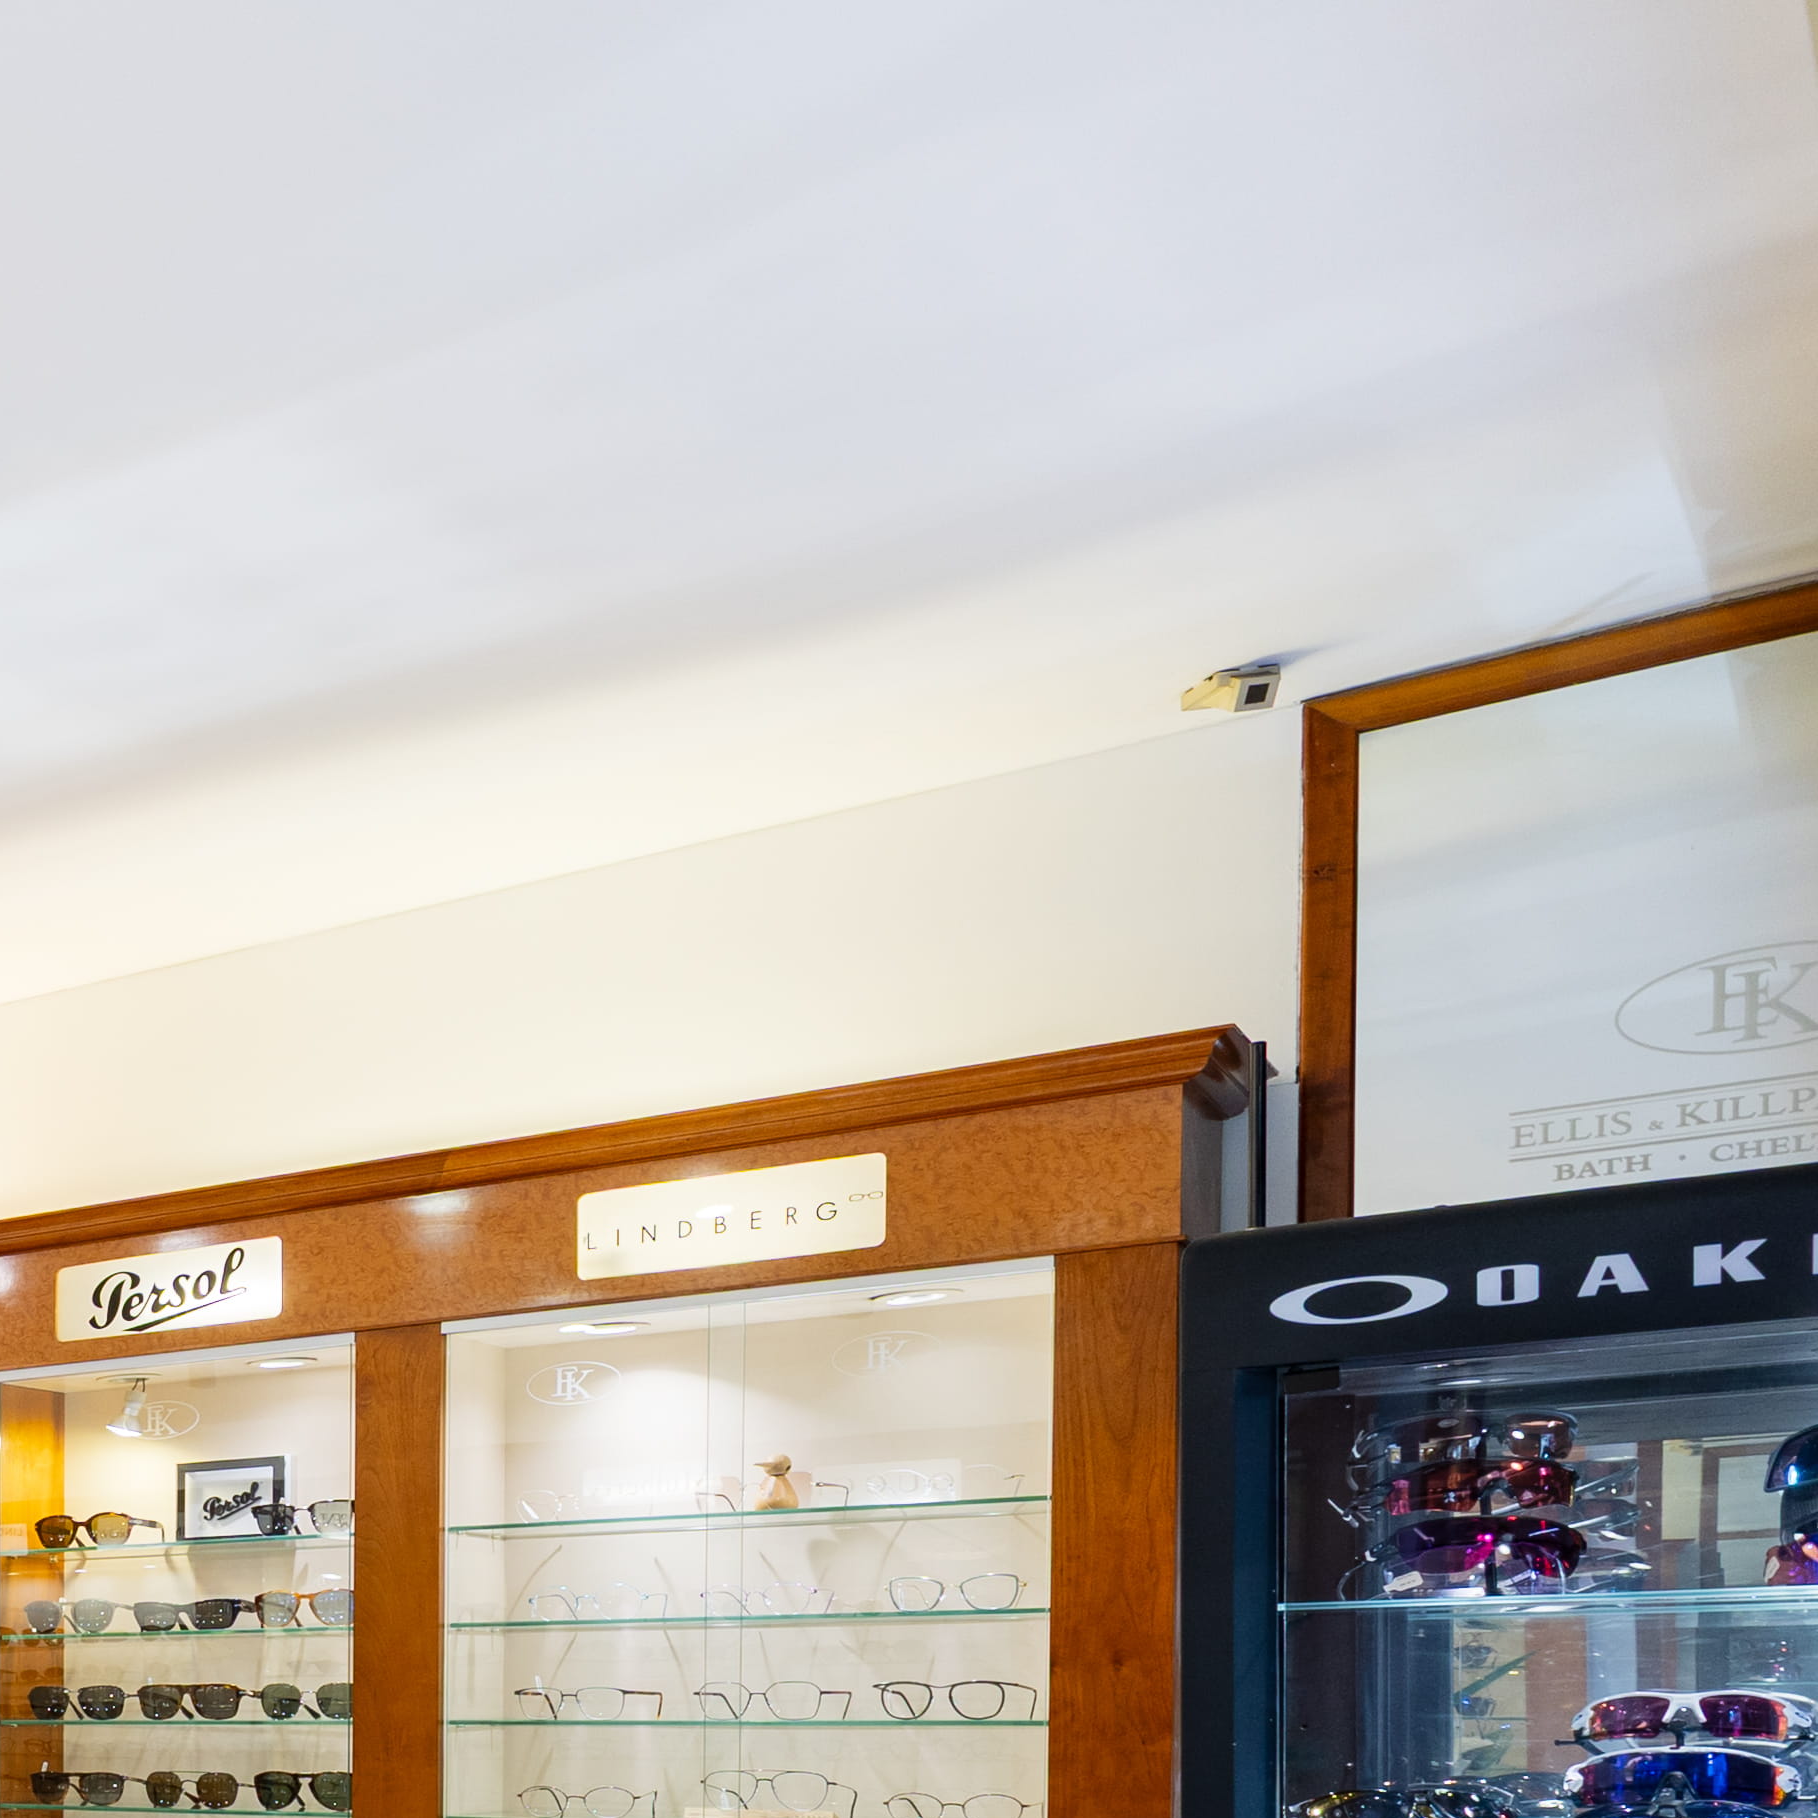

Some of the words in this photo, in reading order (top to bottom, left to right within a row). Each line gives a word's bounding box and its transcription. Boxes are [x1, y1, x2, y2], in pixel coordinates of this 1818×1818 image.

[1509, 1111, 1633, 1149] ELLIS
[1648, 1119, 1664, 1132] &
[1675, 1086, 1818, 1128] KILLP
[1552, 1153, 1653, 1183] BATH
[586, 1201, 838, 1251] LINDBERG
[89, 1247, 247, 1332] Persol
[1475, 1233, 1818, 1308] OAK
[203, 1481, 262, 1521] Persol
